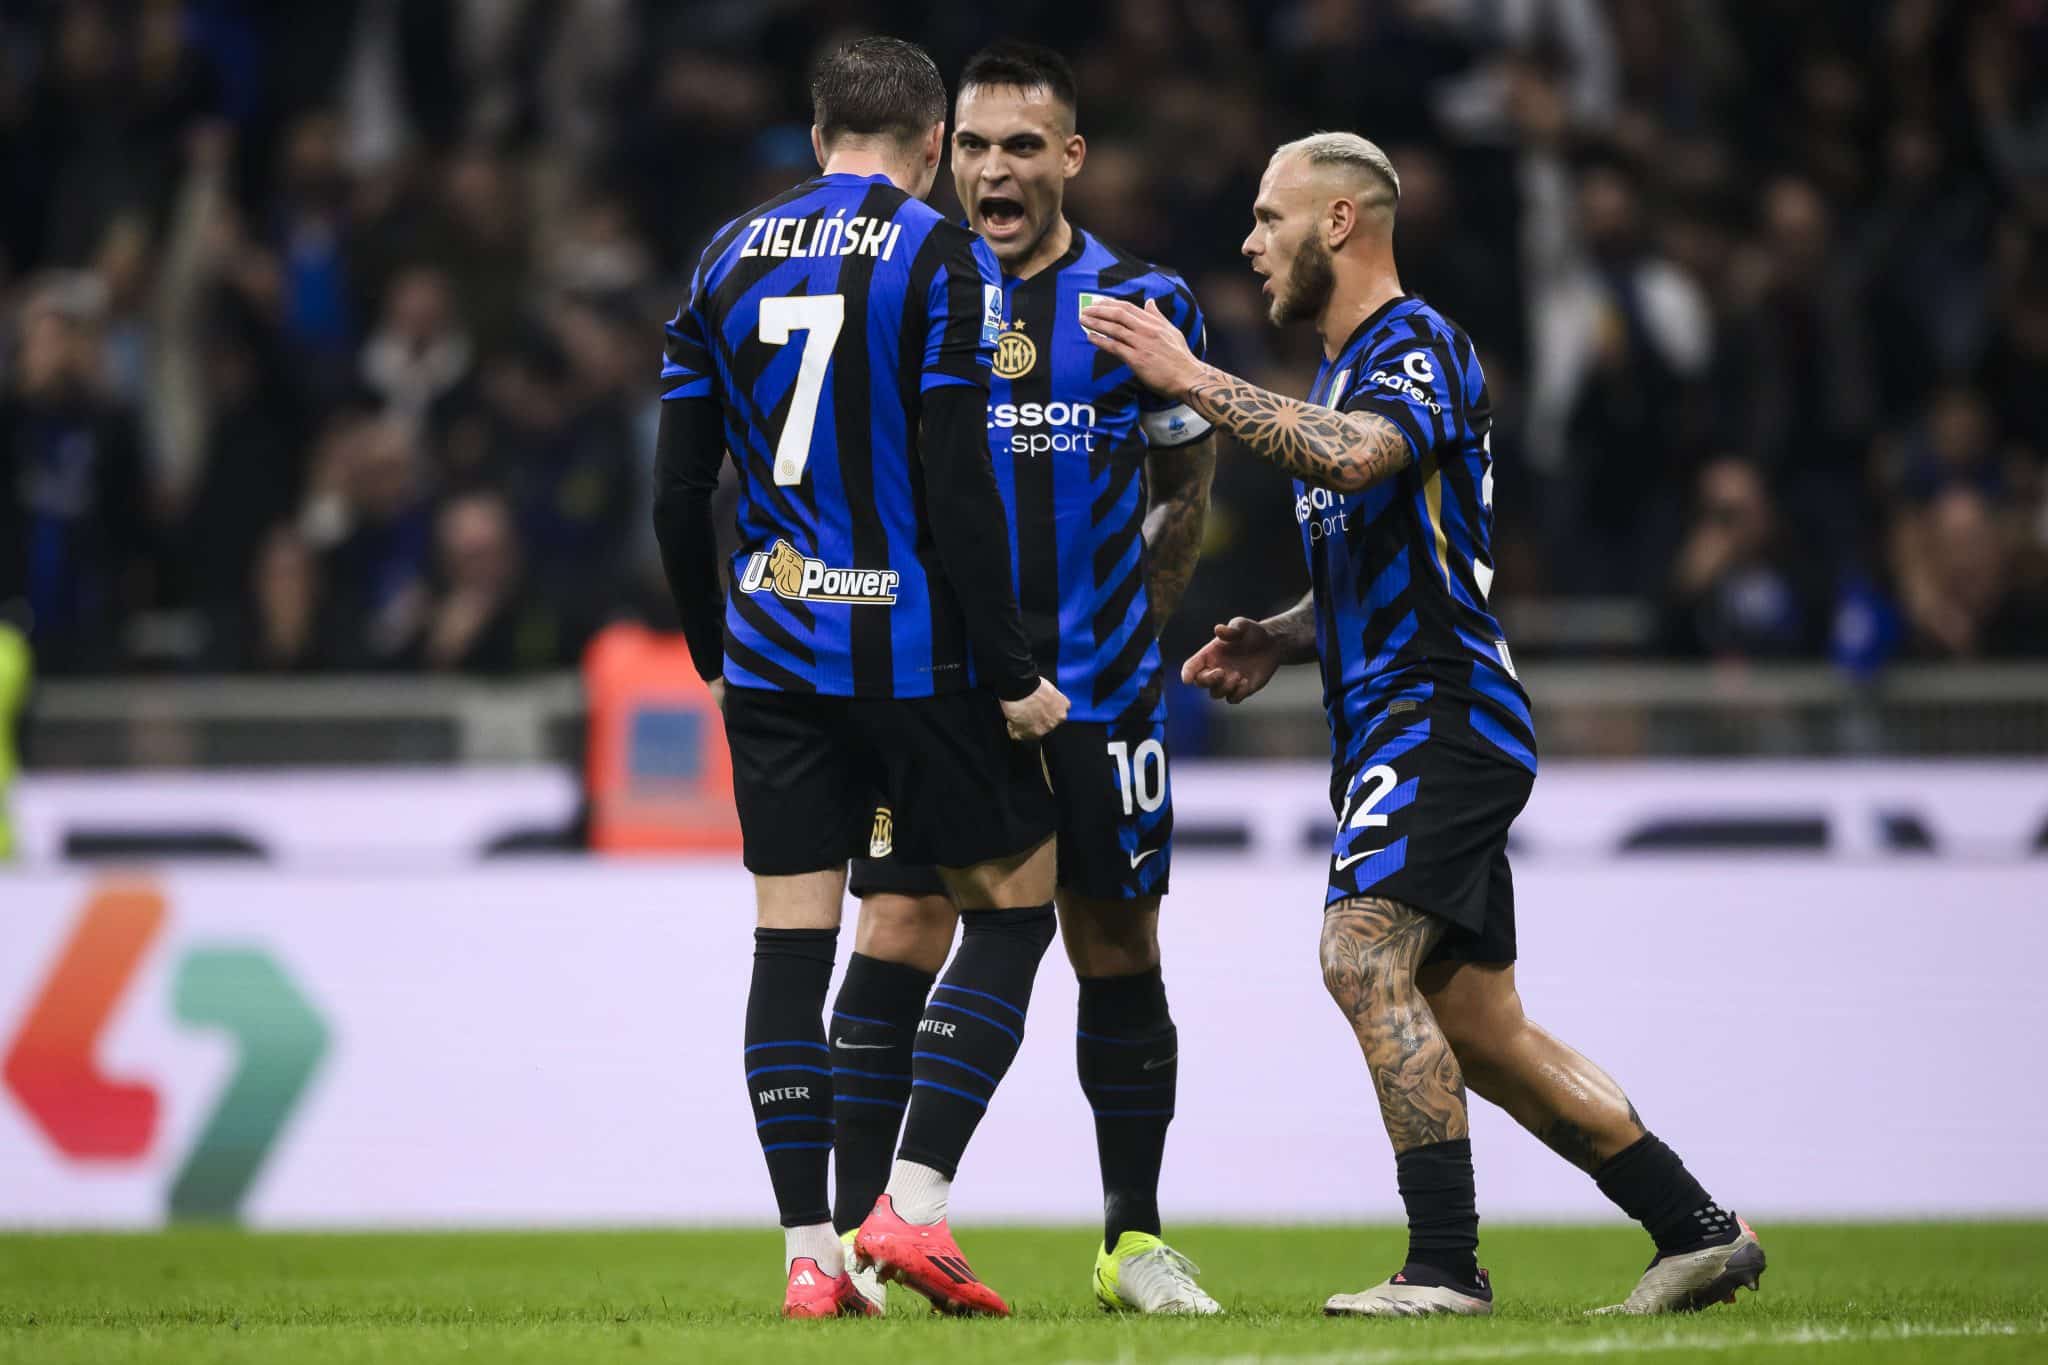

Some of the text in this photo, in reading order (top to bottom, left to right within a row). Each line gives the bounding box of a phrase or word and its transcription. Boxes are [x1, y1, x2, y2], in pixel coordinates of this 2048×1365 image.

[740, 208, 901, 261] ZIELIŃSKI
[759, 294, 845, 486] 7
[1309, 509, 1349, 547] port
[1107, 738, 1167, 816] 10
[917, 1019, 957, 1038] NTER
[759, 1086, 810, 1105] INTER
